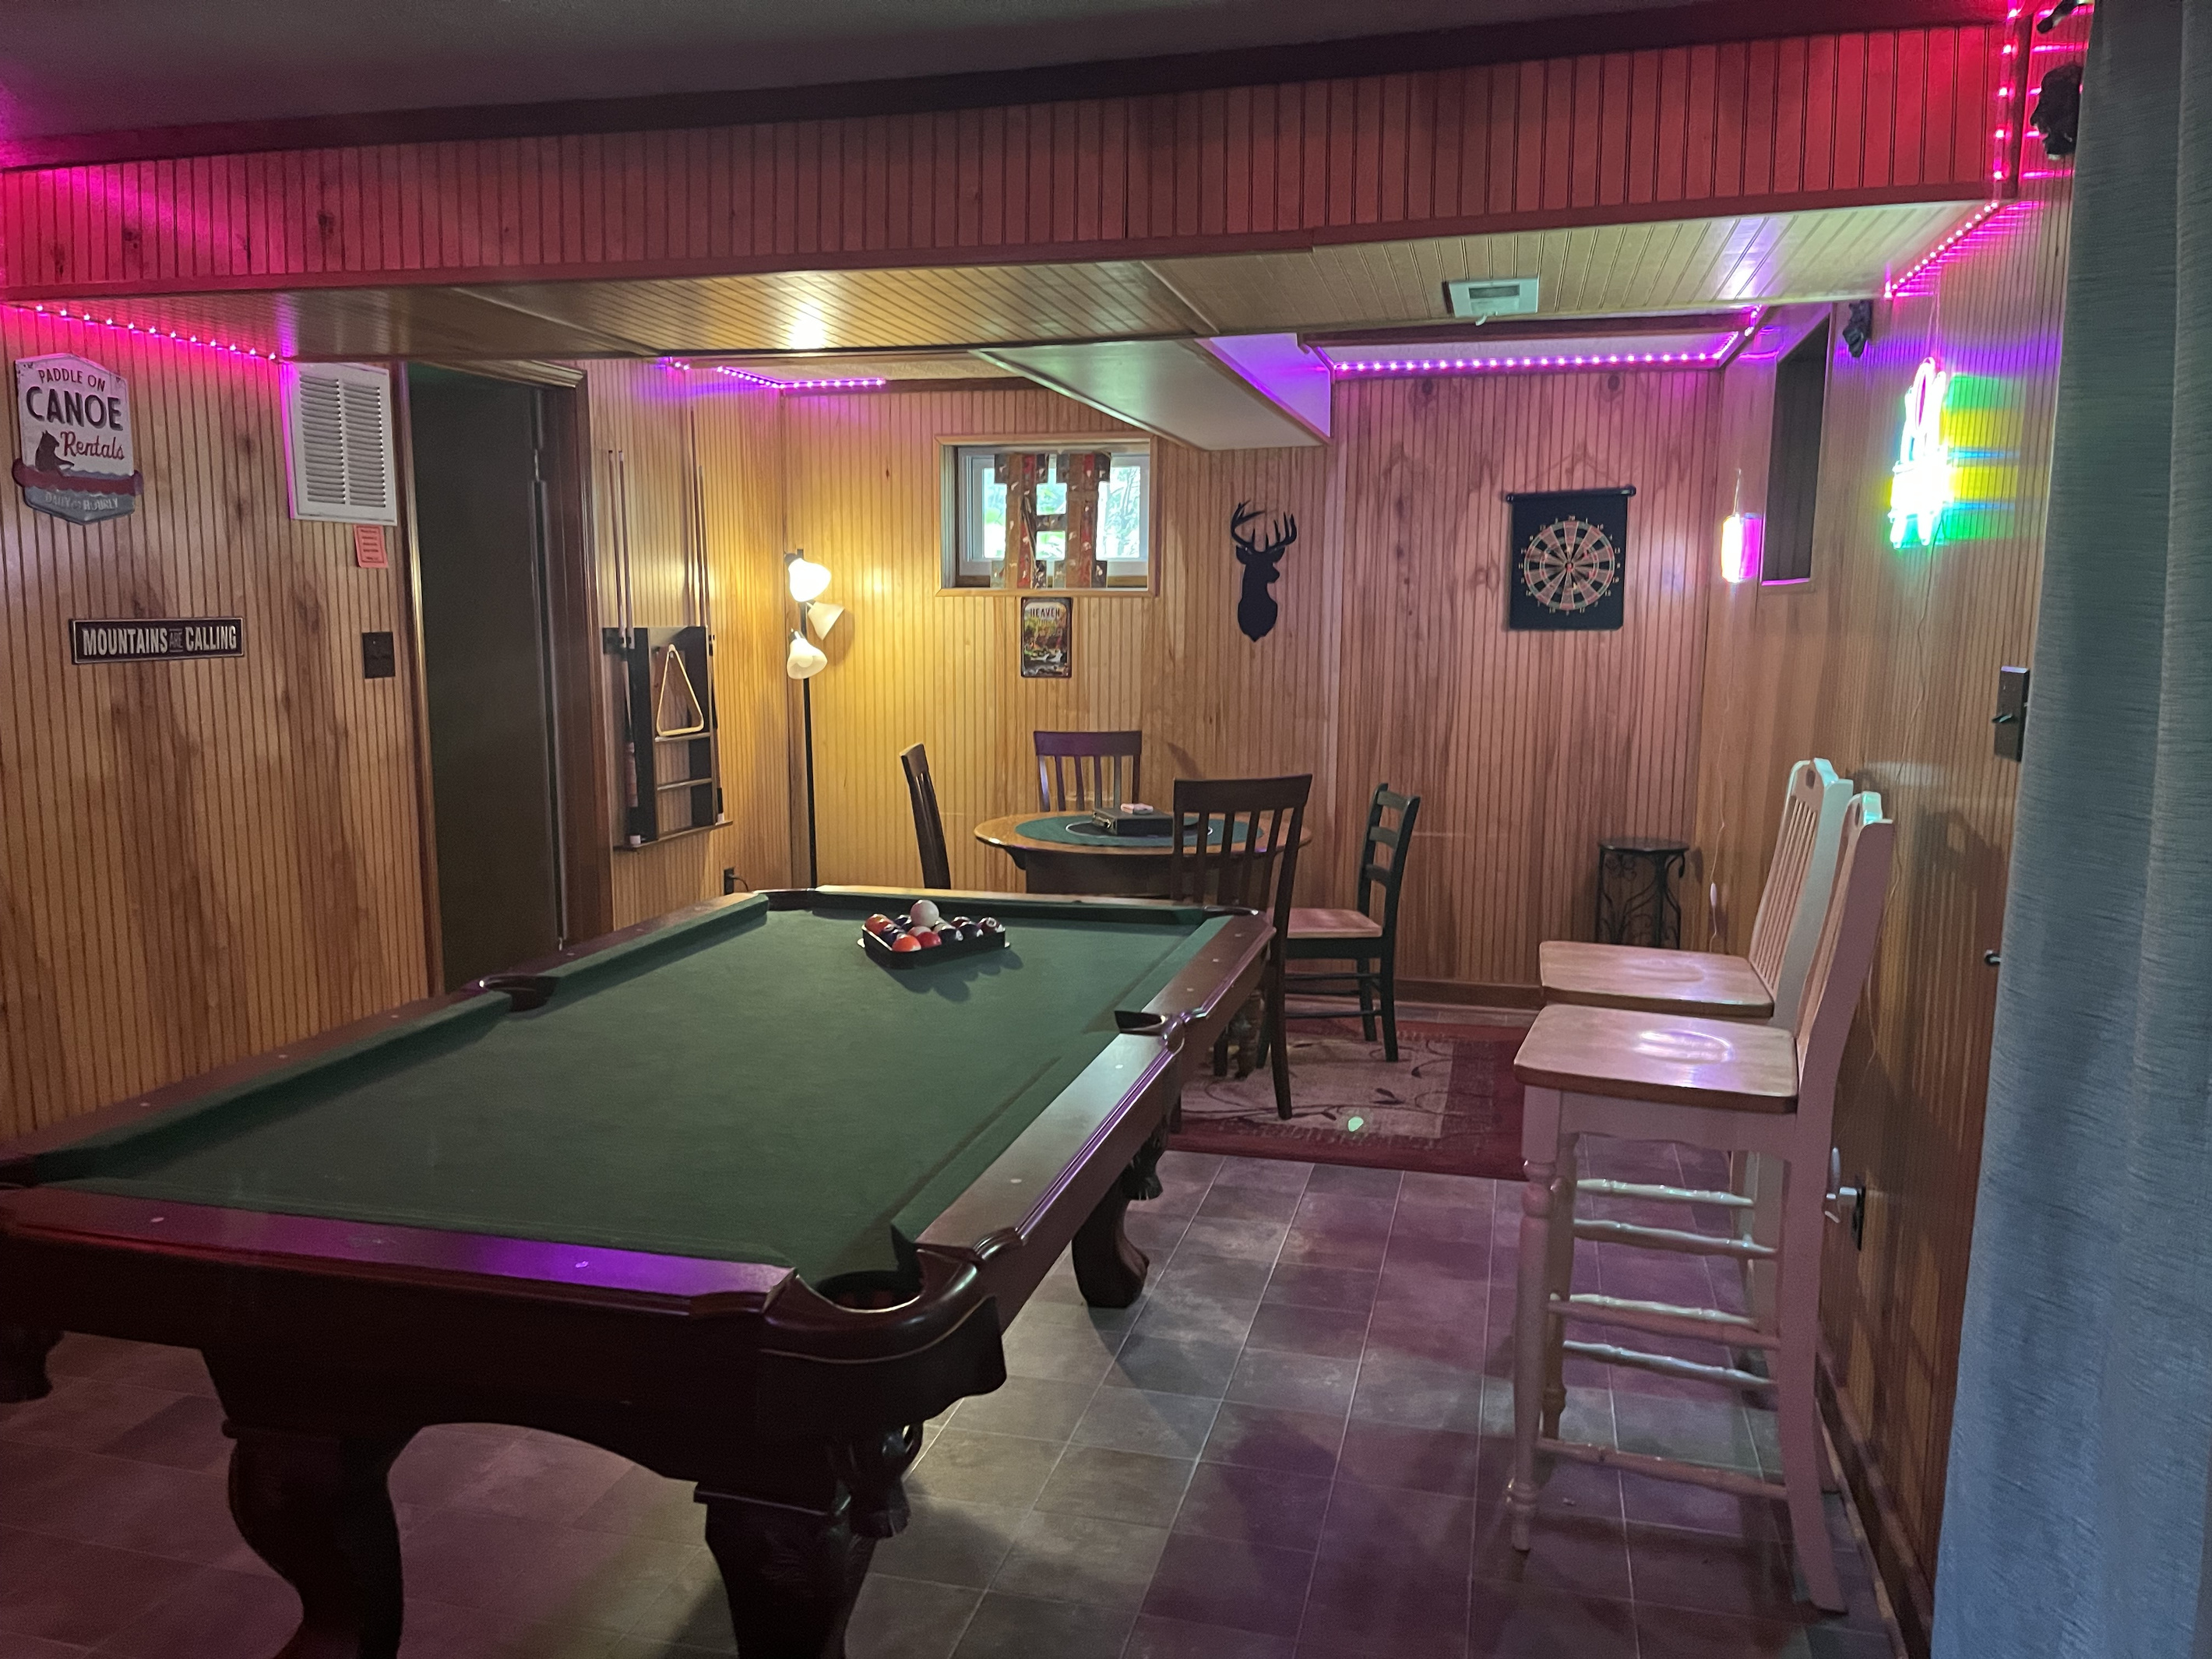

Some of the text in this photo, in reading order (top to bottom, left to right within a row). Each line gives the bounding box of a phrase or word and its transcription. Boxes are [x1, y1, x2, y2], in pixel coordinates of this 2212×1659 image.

[39, 368, 105, 392] PADDLE ON
[26, 386, 123, 431] CANOE
[60, 431, 125, 460] Rentals
[83, 498, 118, 510] HOURLY
[1030, 608, 1060, 618] HEAVEN
[82, 625, 237, 656] MOUNTAINS ARE CALLING
